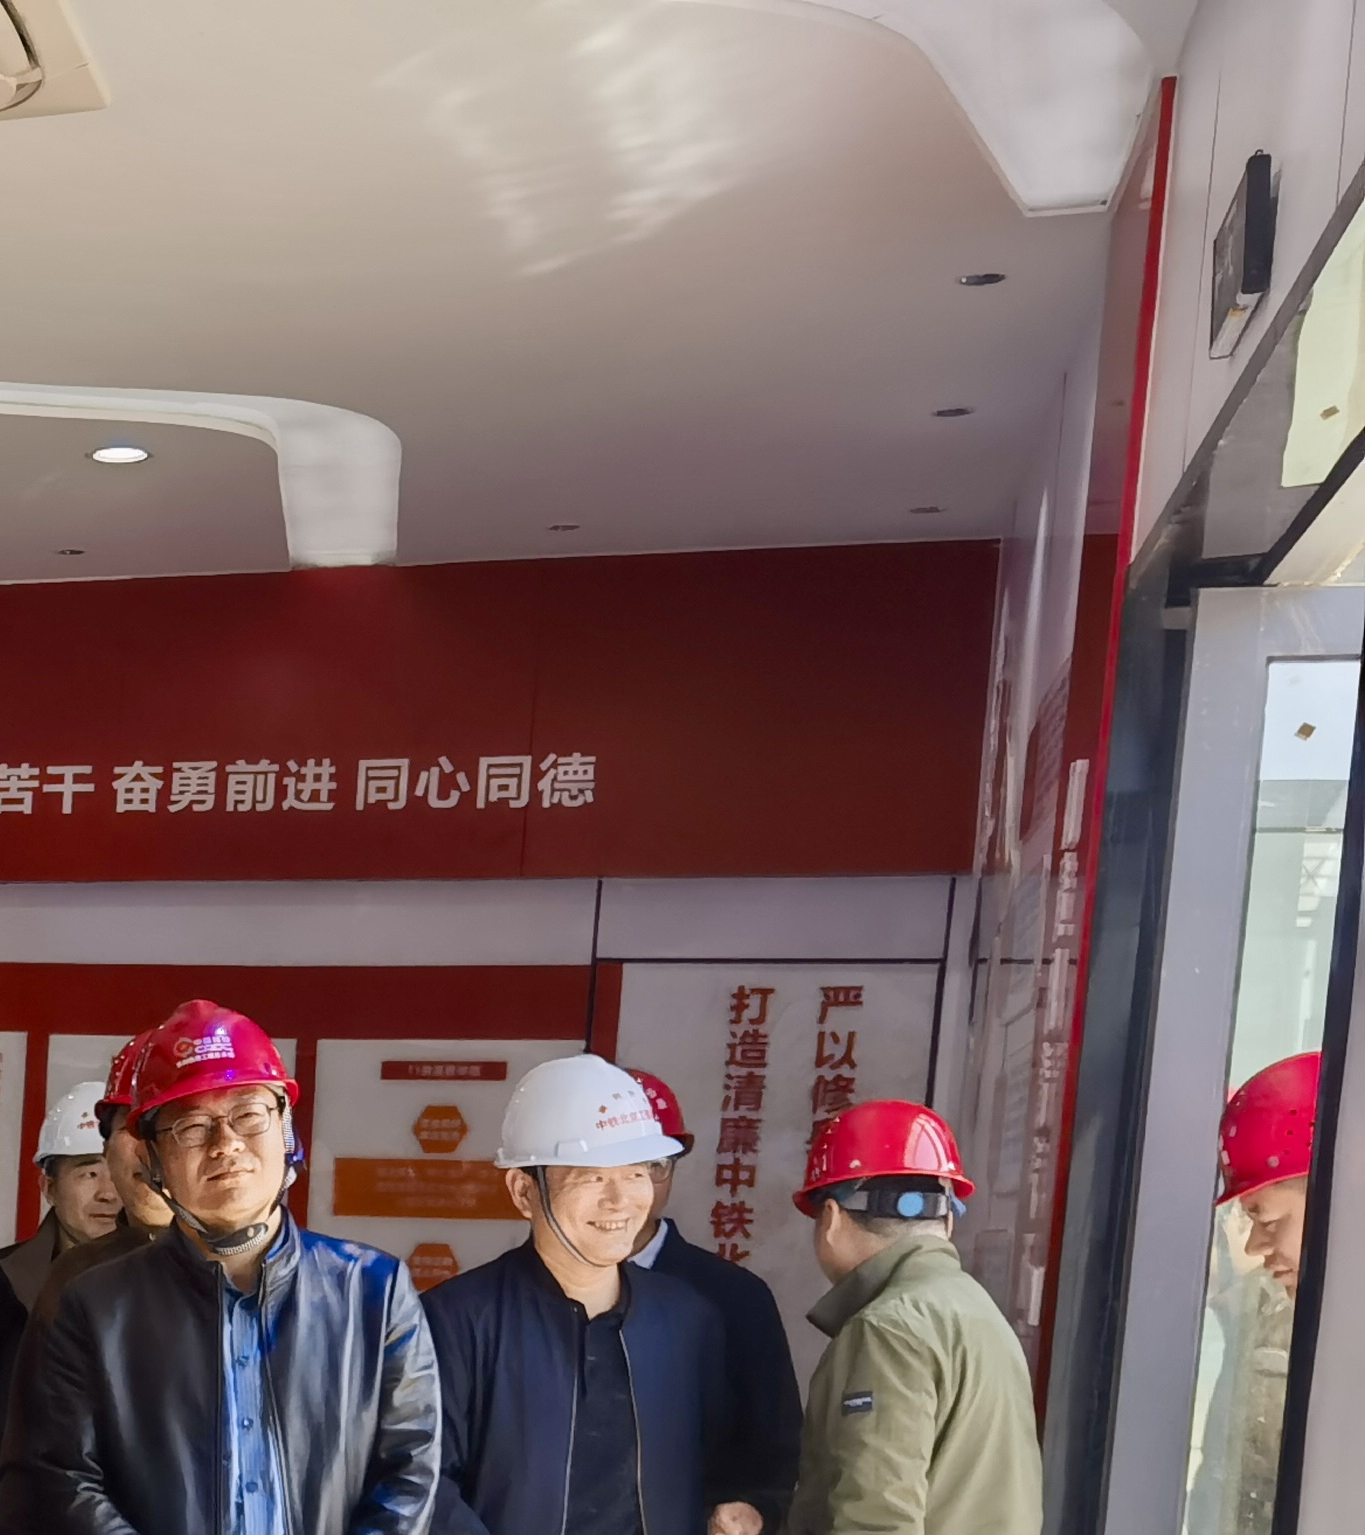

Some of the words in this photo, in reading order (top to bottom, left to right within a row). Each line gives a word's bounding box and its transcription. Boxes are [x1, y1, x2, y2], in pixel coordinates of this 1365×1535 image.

[111, 758, 337, 815] 奋勇前进
[356, 752, 597, 811] 同心同德
[806, 984, 865, 1155] 严以修
